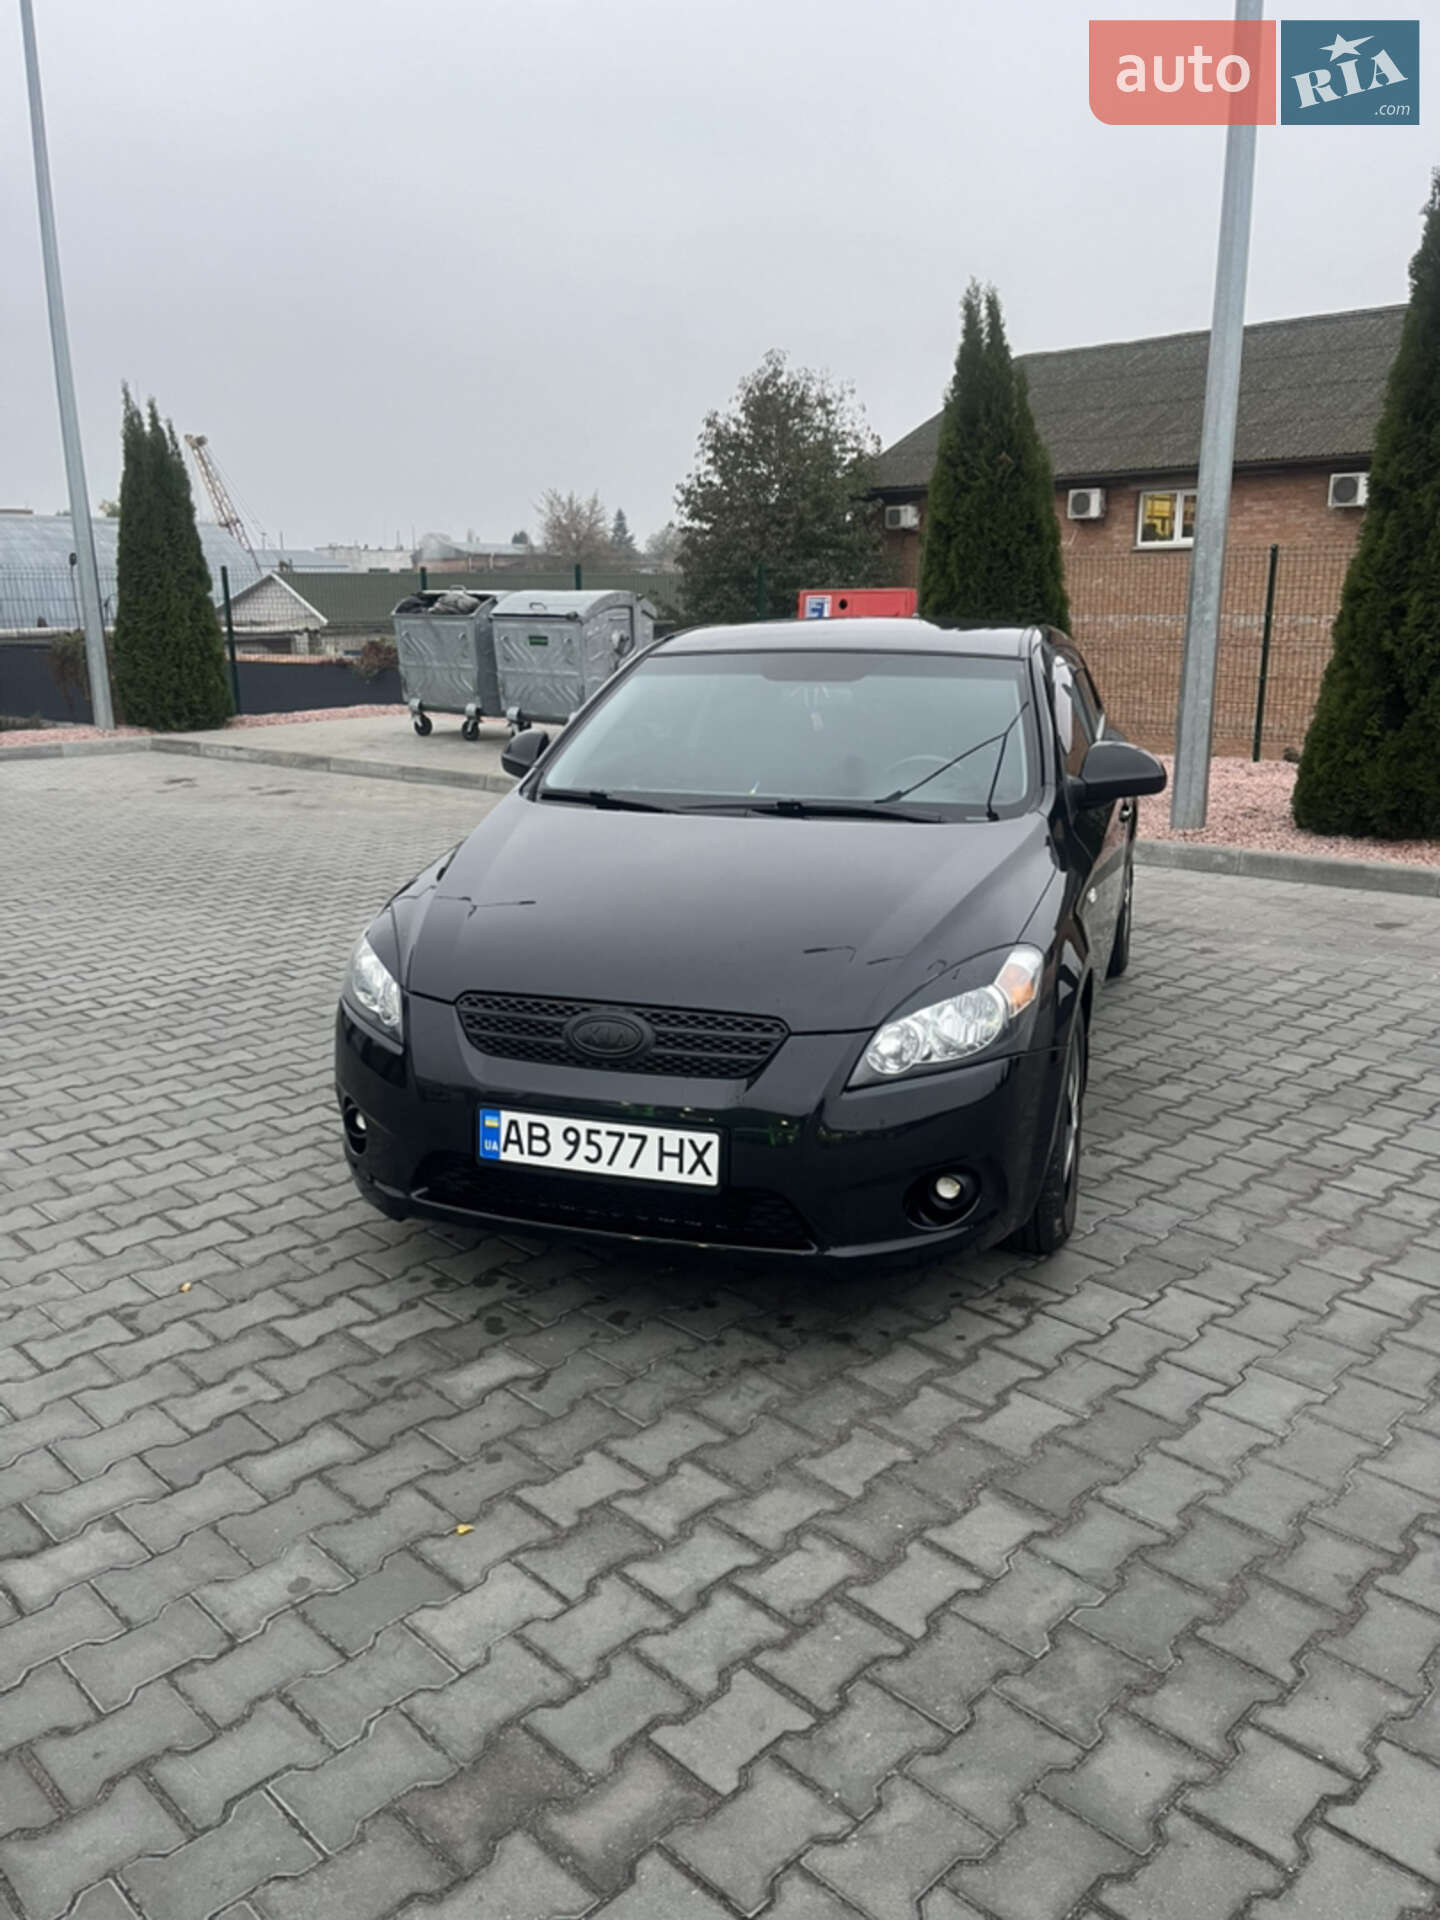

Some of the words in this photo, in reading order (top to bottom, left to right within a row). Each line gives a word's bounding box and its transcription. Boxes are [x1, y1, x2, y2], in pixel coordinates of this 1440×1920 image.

[484, 1139, 498, 1151] UA
[502, 1119, 551, 1157] AB
[562, 1126, 648, 1168] 9577
[658, 1136, 713, 1176] HX
